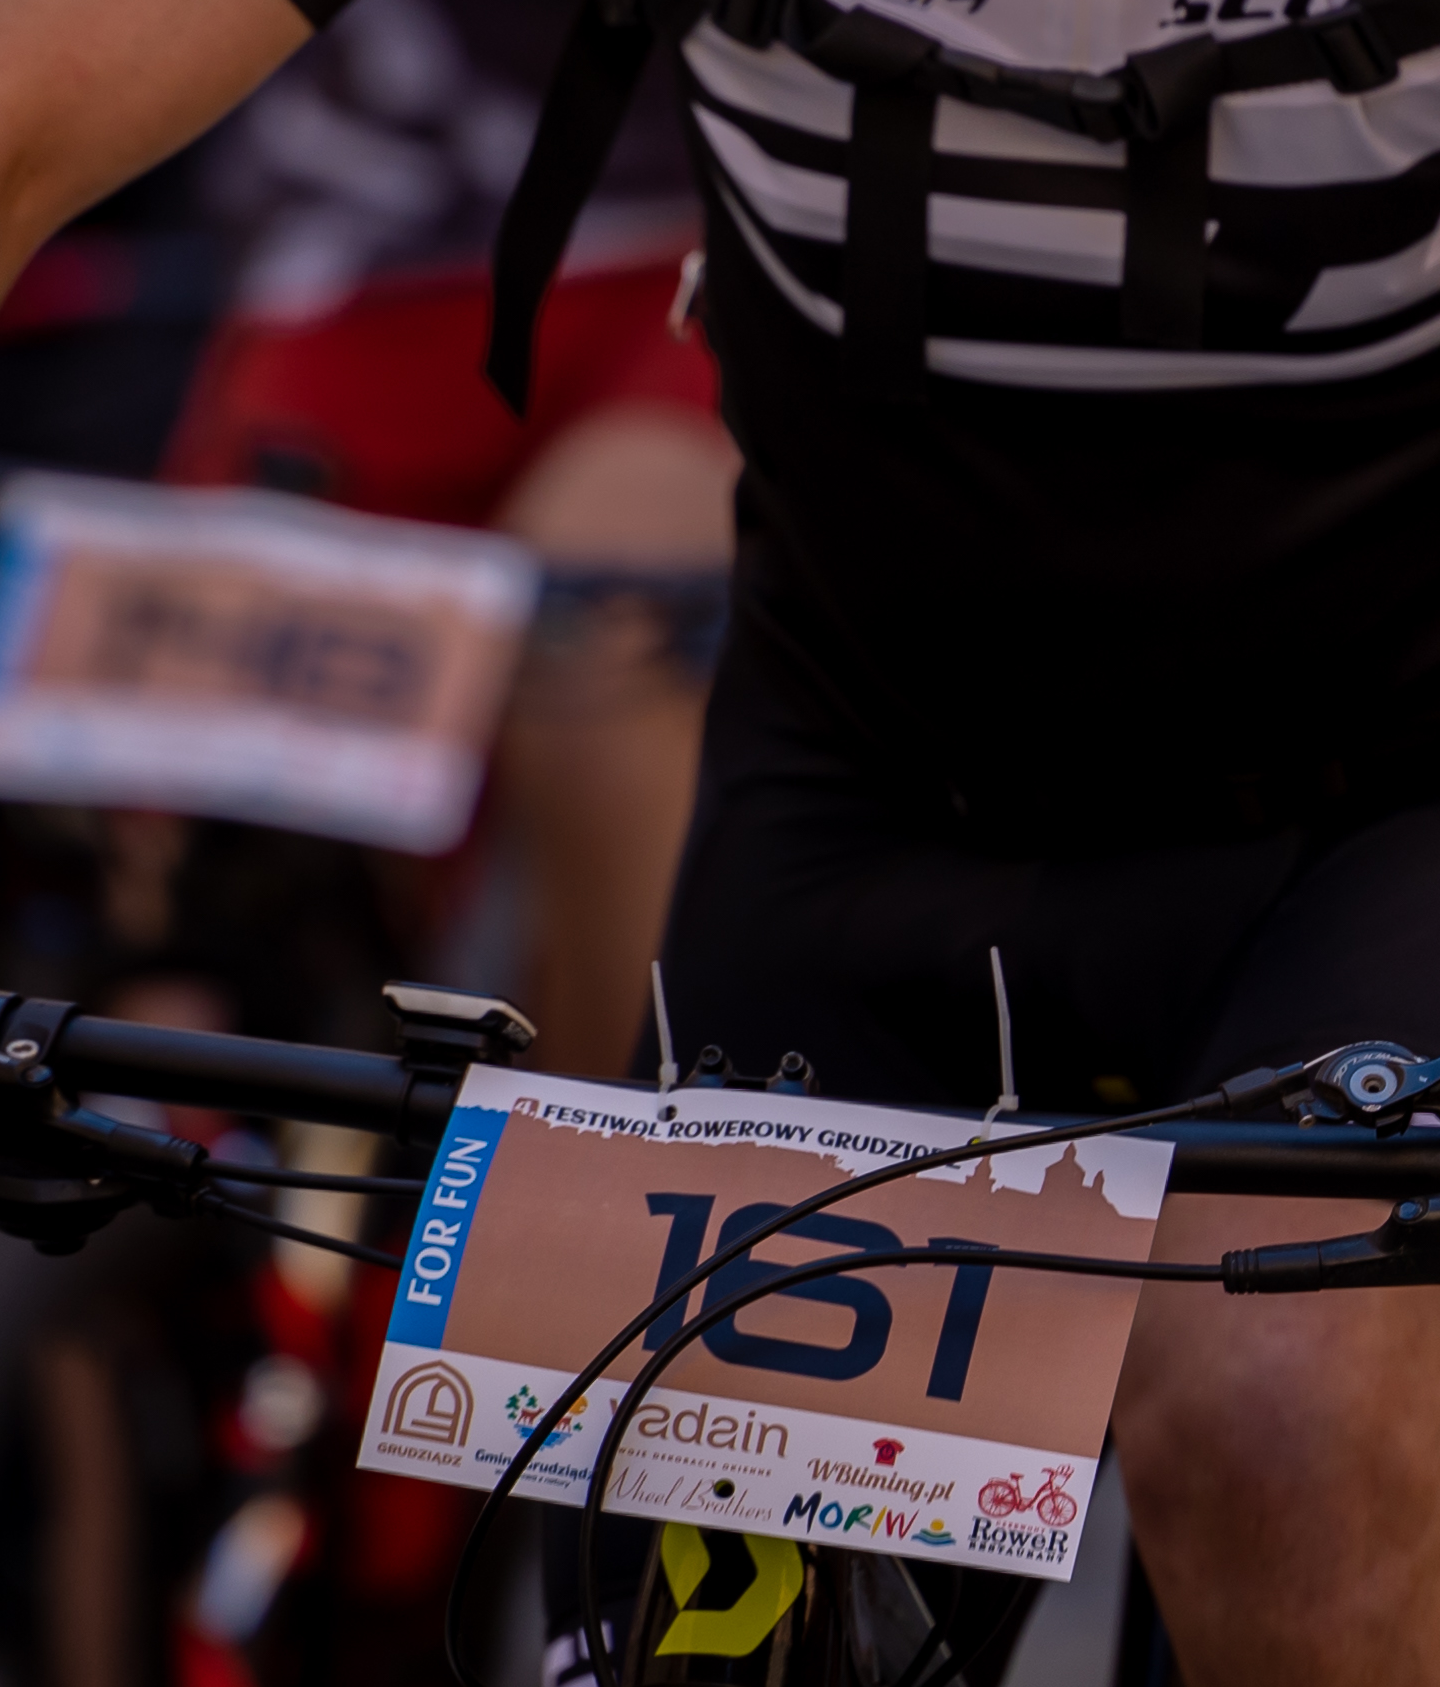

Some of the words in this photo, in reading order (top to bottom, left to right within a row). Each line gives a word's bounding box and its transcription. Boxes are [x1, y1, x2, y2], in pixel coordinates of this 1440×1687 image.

[667, 1119, 814, 1144] ROWEROWY
[817, 1129, 961, 1169] GRUDZI
[432, 1137, 489, 1209] FUN
[406, 1218, 462, 1306] FOR
[642, 1192, 1000, 1402] 161
[377, 1441, 463, 1467] GRUDZIĄDZ
[475, 1448, 512, 1467] Gmin
[528, 1461, 593, 1482] rudziąd
[608, 1466, 685, 1507] Wheel
[680, 1477, 773, 1522] Brothers
[808, 1458, 955, 1505] WBtiming.pl
[783, 1491, 920, 1541] MORIW
